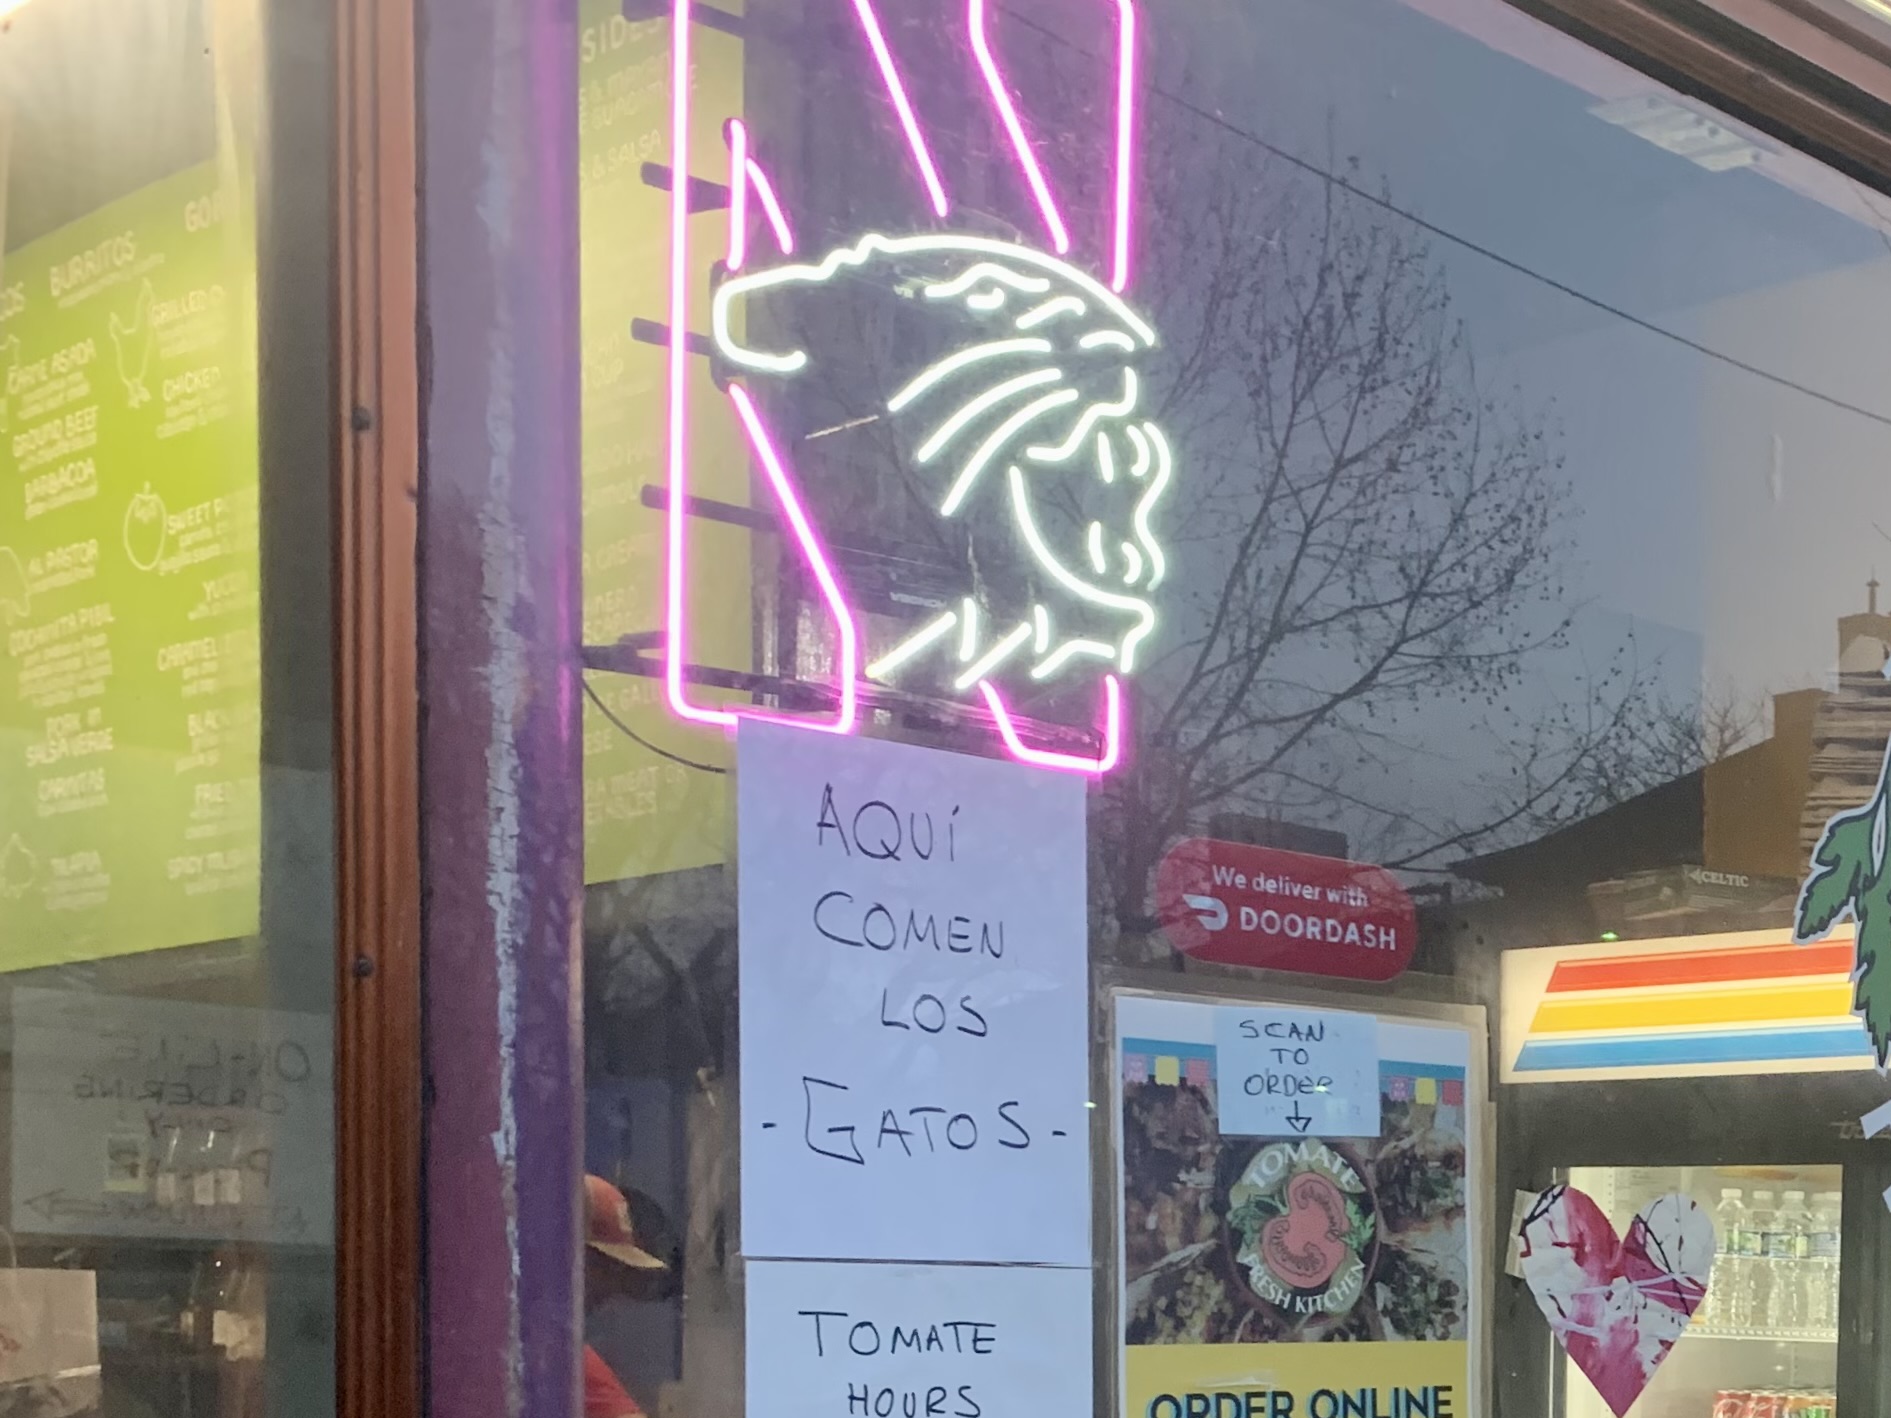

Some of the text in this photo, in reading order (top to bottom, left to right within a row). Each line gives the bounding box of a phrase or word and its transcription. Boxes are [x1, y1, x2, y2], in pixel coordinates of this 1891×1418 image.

[50, 230, 137, 297] BURRITOS
[1212, 865, 1368, 907] We deliver with
[814, 890, 1004, 958] COMEN
[1240, 906, 1396, 951] DOORDASH
[881, 988, 988, 1037] LOS
[1239, 1019, 1326, 1043] SCAN
[1270, 1047, 1310, 1065] TO
[1241, 1140, 1360, 1192] TOMATE
[1295, 1257, 1366, 1314] KITCHEN
[798, 1311, 997, 1357] TOMATE
[848, 1382, 981, 1418] HOURS
